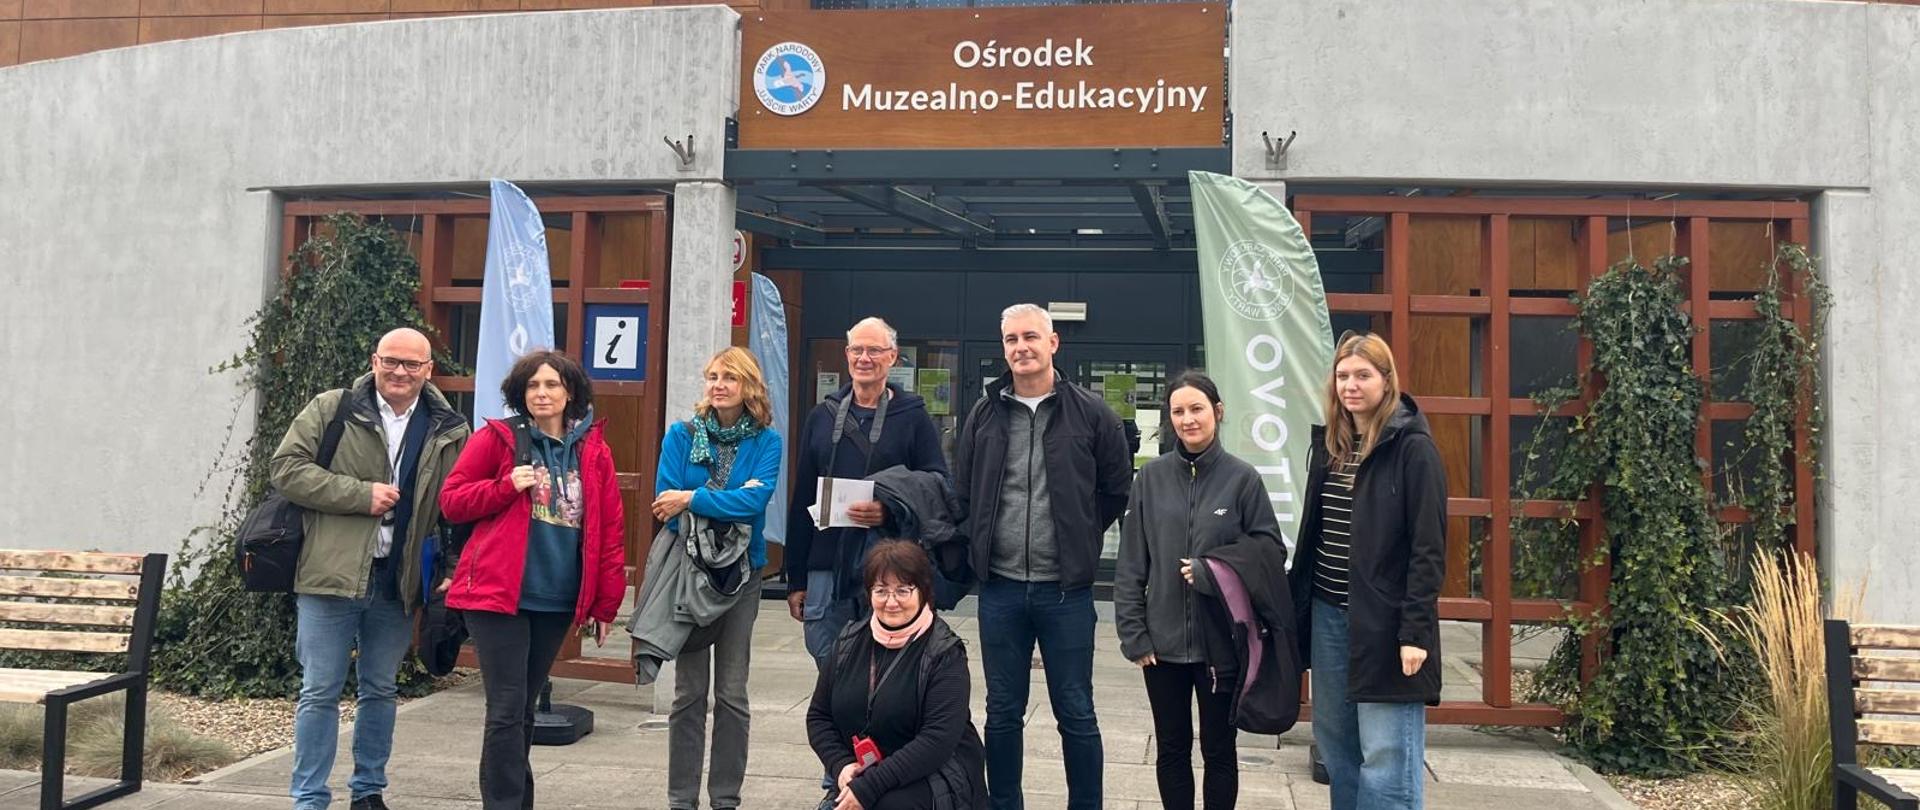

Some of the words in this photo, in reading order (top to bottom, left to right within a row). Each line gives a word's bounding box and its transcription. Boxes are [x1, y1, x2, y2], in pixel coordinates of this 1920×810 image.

[757, 51, 776, 74] PARK
[775, 44, 822, 73] NARODOWY
[953, 37, 1094, 68] Ośrodek
[842, 79, 1208, 113] Muzealno-Edukacyjny
[605, 320, 626, 364] i
